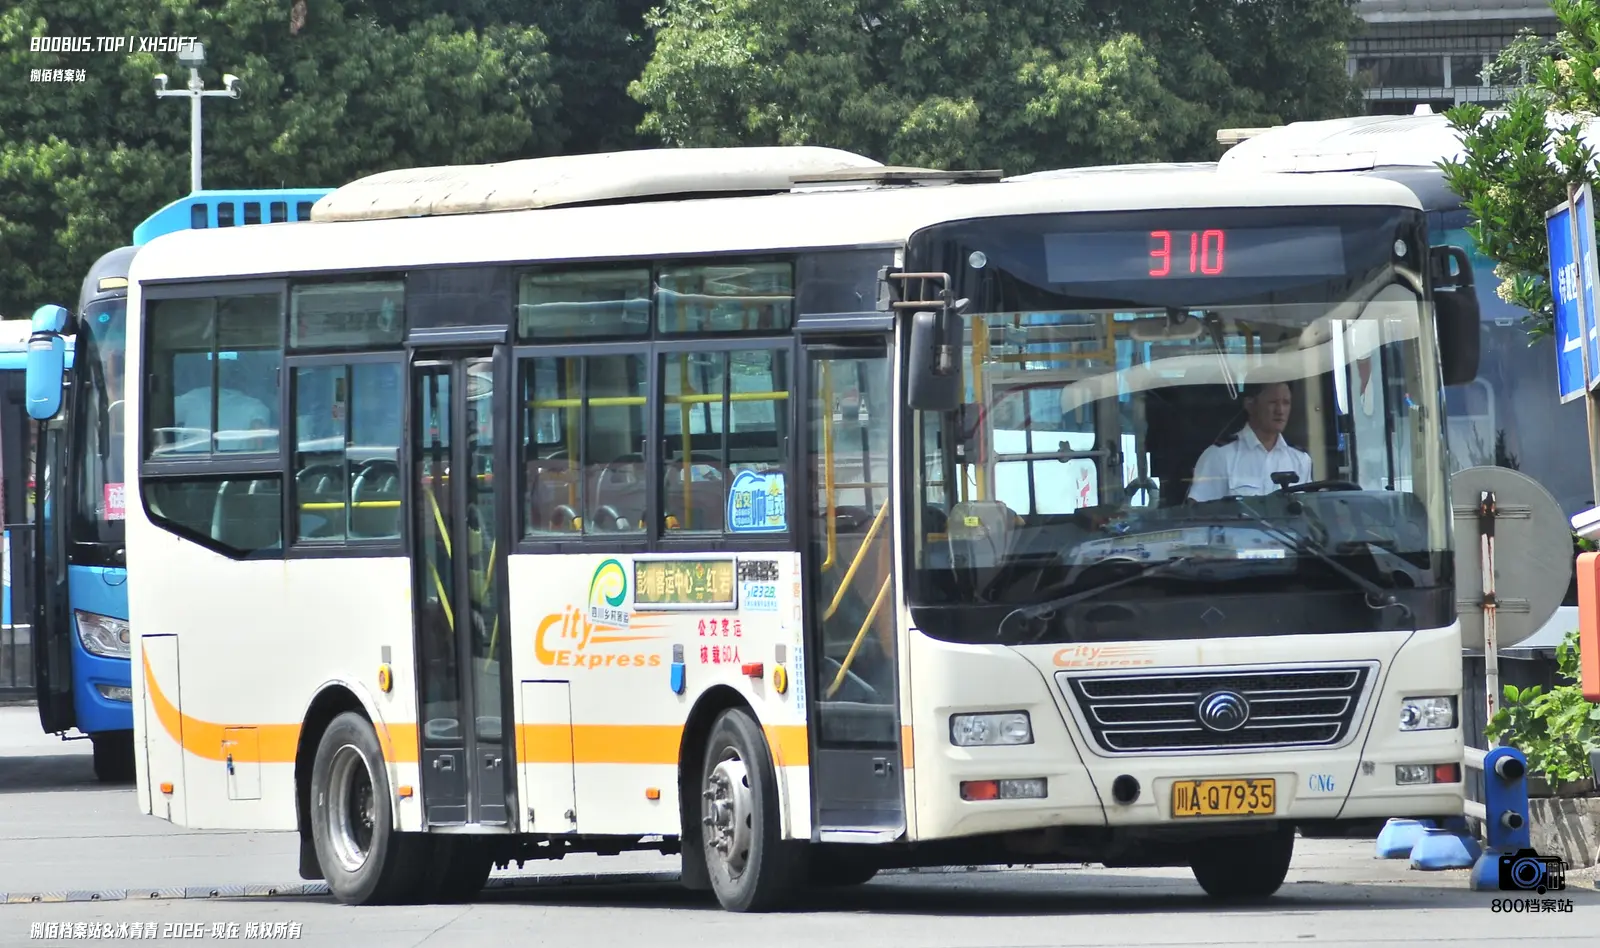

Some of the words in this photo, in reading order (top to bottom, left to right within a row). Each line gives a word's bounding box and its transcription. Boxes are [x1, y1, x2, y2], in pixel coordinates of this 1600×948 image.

[1149, 229, 1225, 277] 310
[534, 604, 594, 666] City
[697, 618, 742, 637] 公交客运
[556, 649, 661, 669] Express
[700, 645, 741, 664] 核载60人
[1053, 645, 1101, 668] City
[1069, 659, 1154, 668] Express
[1308, 774, 1335, 793] CNG
